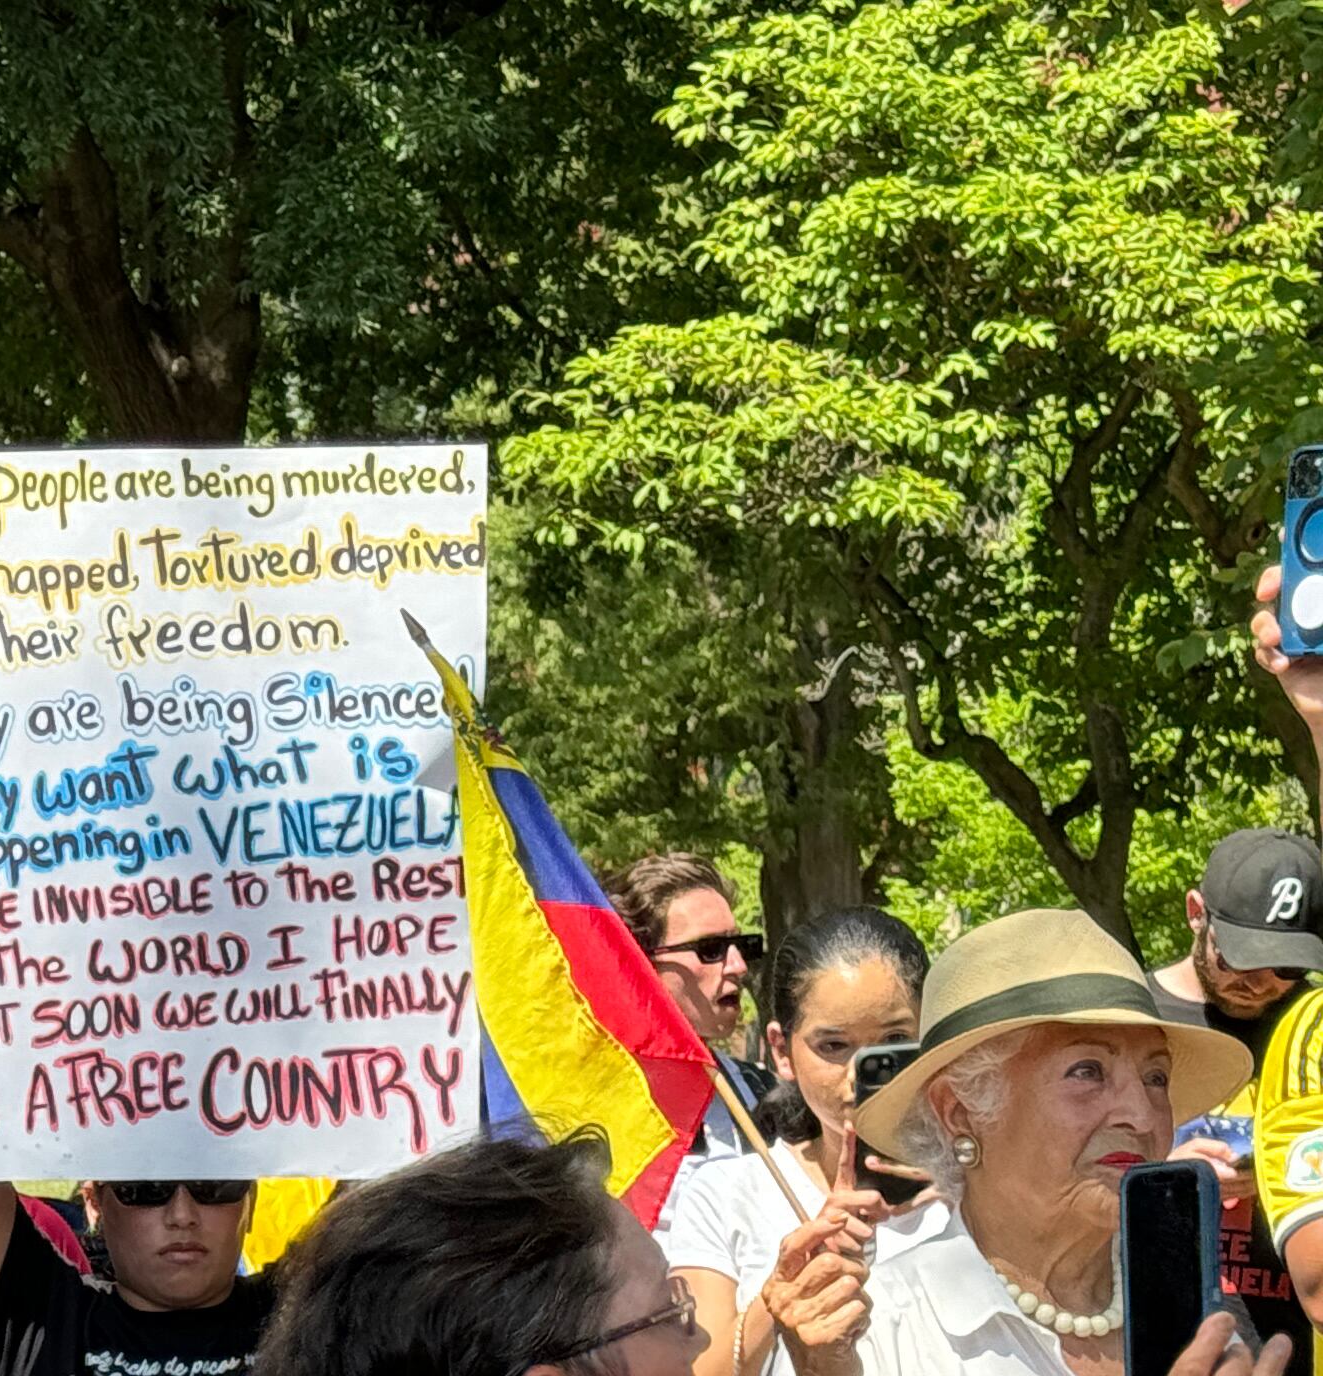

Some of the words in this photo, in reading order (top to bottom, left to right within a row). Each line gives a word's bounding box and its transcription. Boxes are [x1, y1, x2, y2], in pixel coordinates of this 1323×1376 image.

[115, 470, 175, 500] are
[182, 458, 274, 517] being
[284, 451, 475, 496] murdered,
[332, 521, 486, 583] deprived
[107, 603, 349, 660] freedom.
[28, 698, 99, 738] are
[122, 680, 253, 745] being
[267, 664, 470, 732] Silence
[36, 746, 156, 813] want
[351, 736, 415, 782] is
[150, 815, 190, 862] in
[33, 871, 212, 925] INVISIBLE
[89, 931, 248, 983] WORLD
[267, 925, 306, 970] I
[334, 913, 458, 963] HOPE
[31, 994, 142, 1049] SOON
[155, 992, 217, 1029] WE
[225, 983, 308, 1024] WILL
[27, 1064, 60, 1133] A
[55, 1049, 190, 1128] FREE
